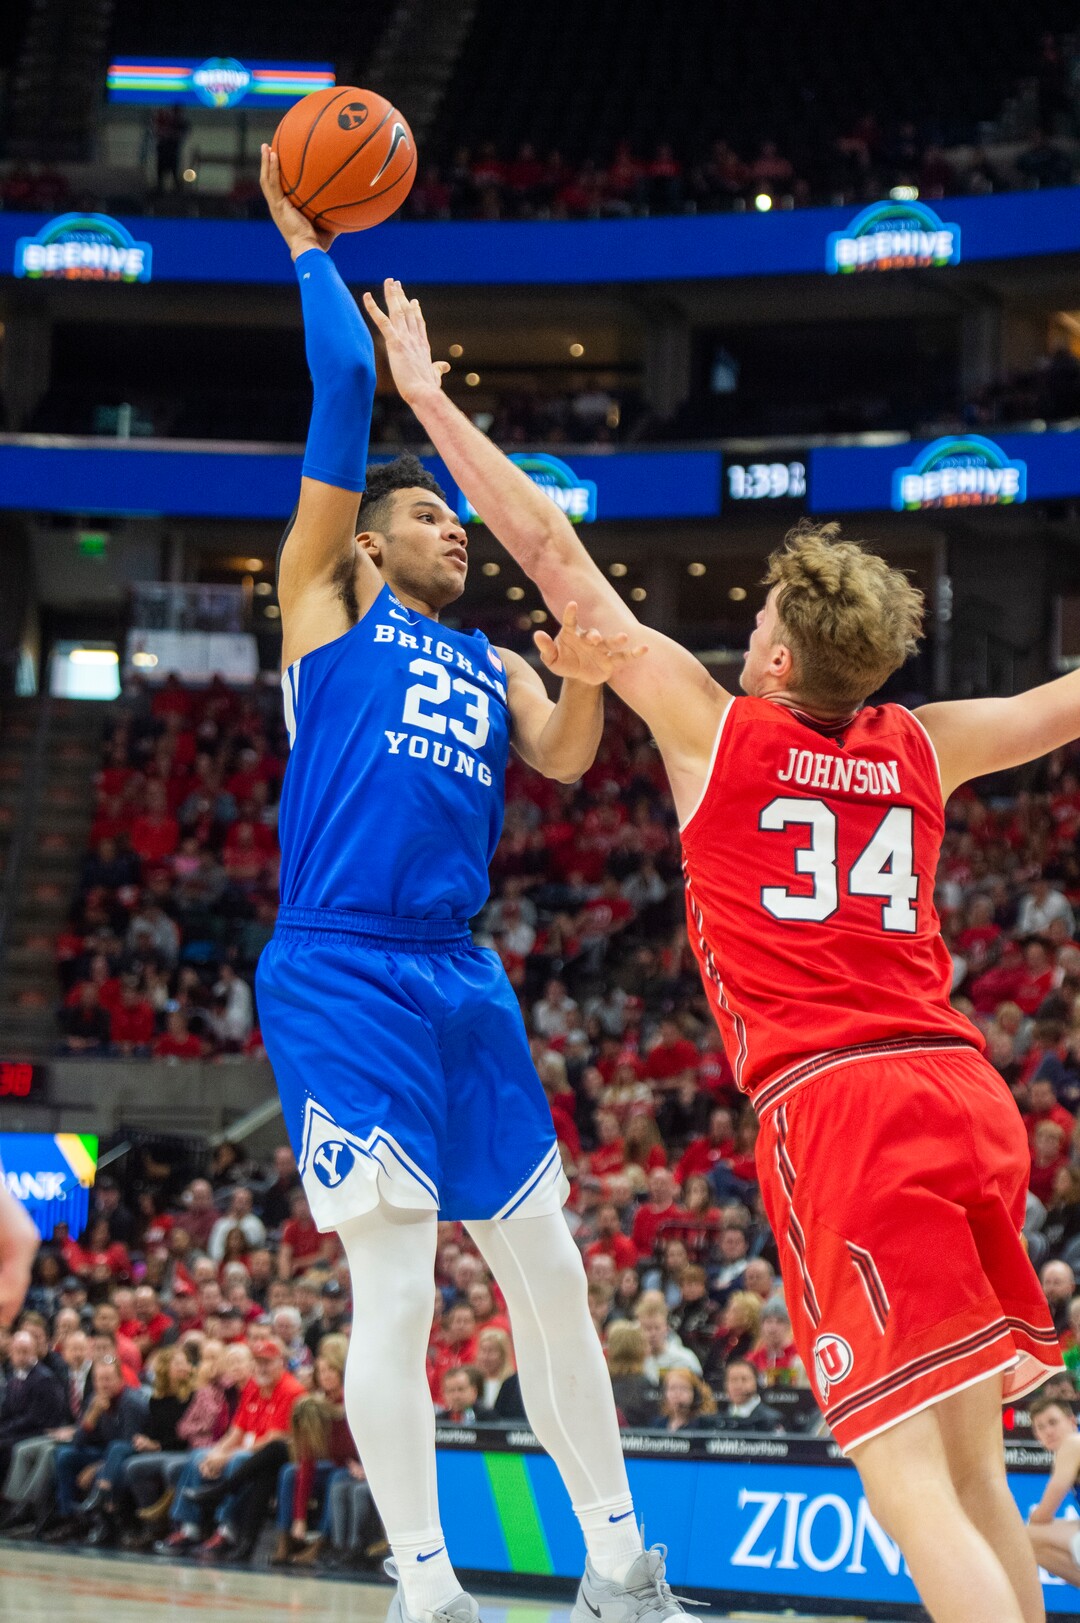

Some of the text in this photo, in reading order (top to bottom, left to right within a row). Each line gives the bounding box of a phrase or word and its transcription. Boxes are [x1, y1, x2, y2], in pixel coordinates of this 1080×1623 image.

[24, 241, 145, 276] BEEHIVE
[835, 230, 954, 266] BEEHIVE
[902, 467, 1020, 504] BEEHIVE
[402, 657, 490, 750] 23
[384, 730, 493, 787] YOUNG
[777, 748, 901, 795] JOHNSON
[758, 795, 920, 934] 34
[0, 1170, 66, 1200] ANK
[731, 1488, 912, 1579] ZION
